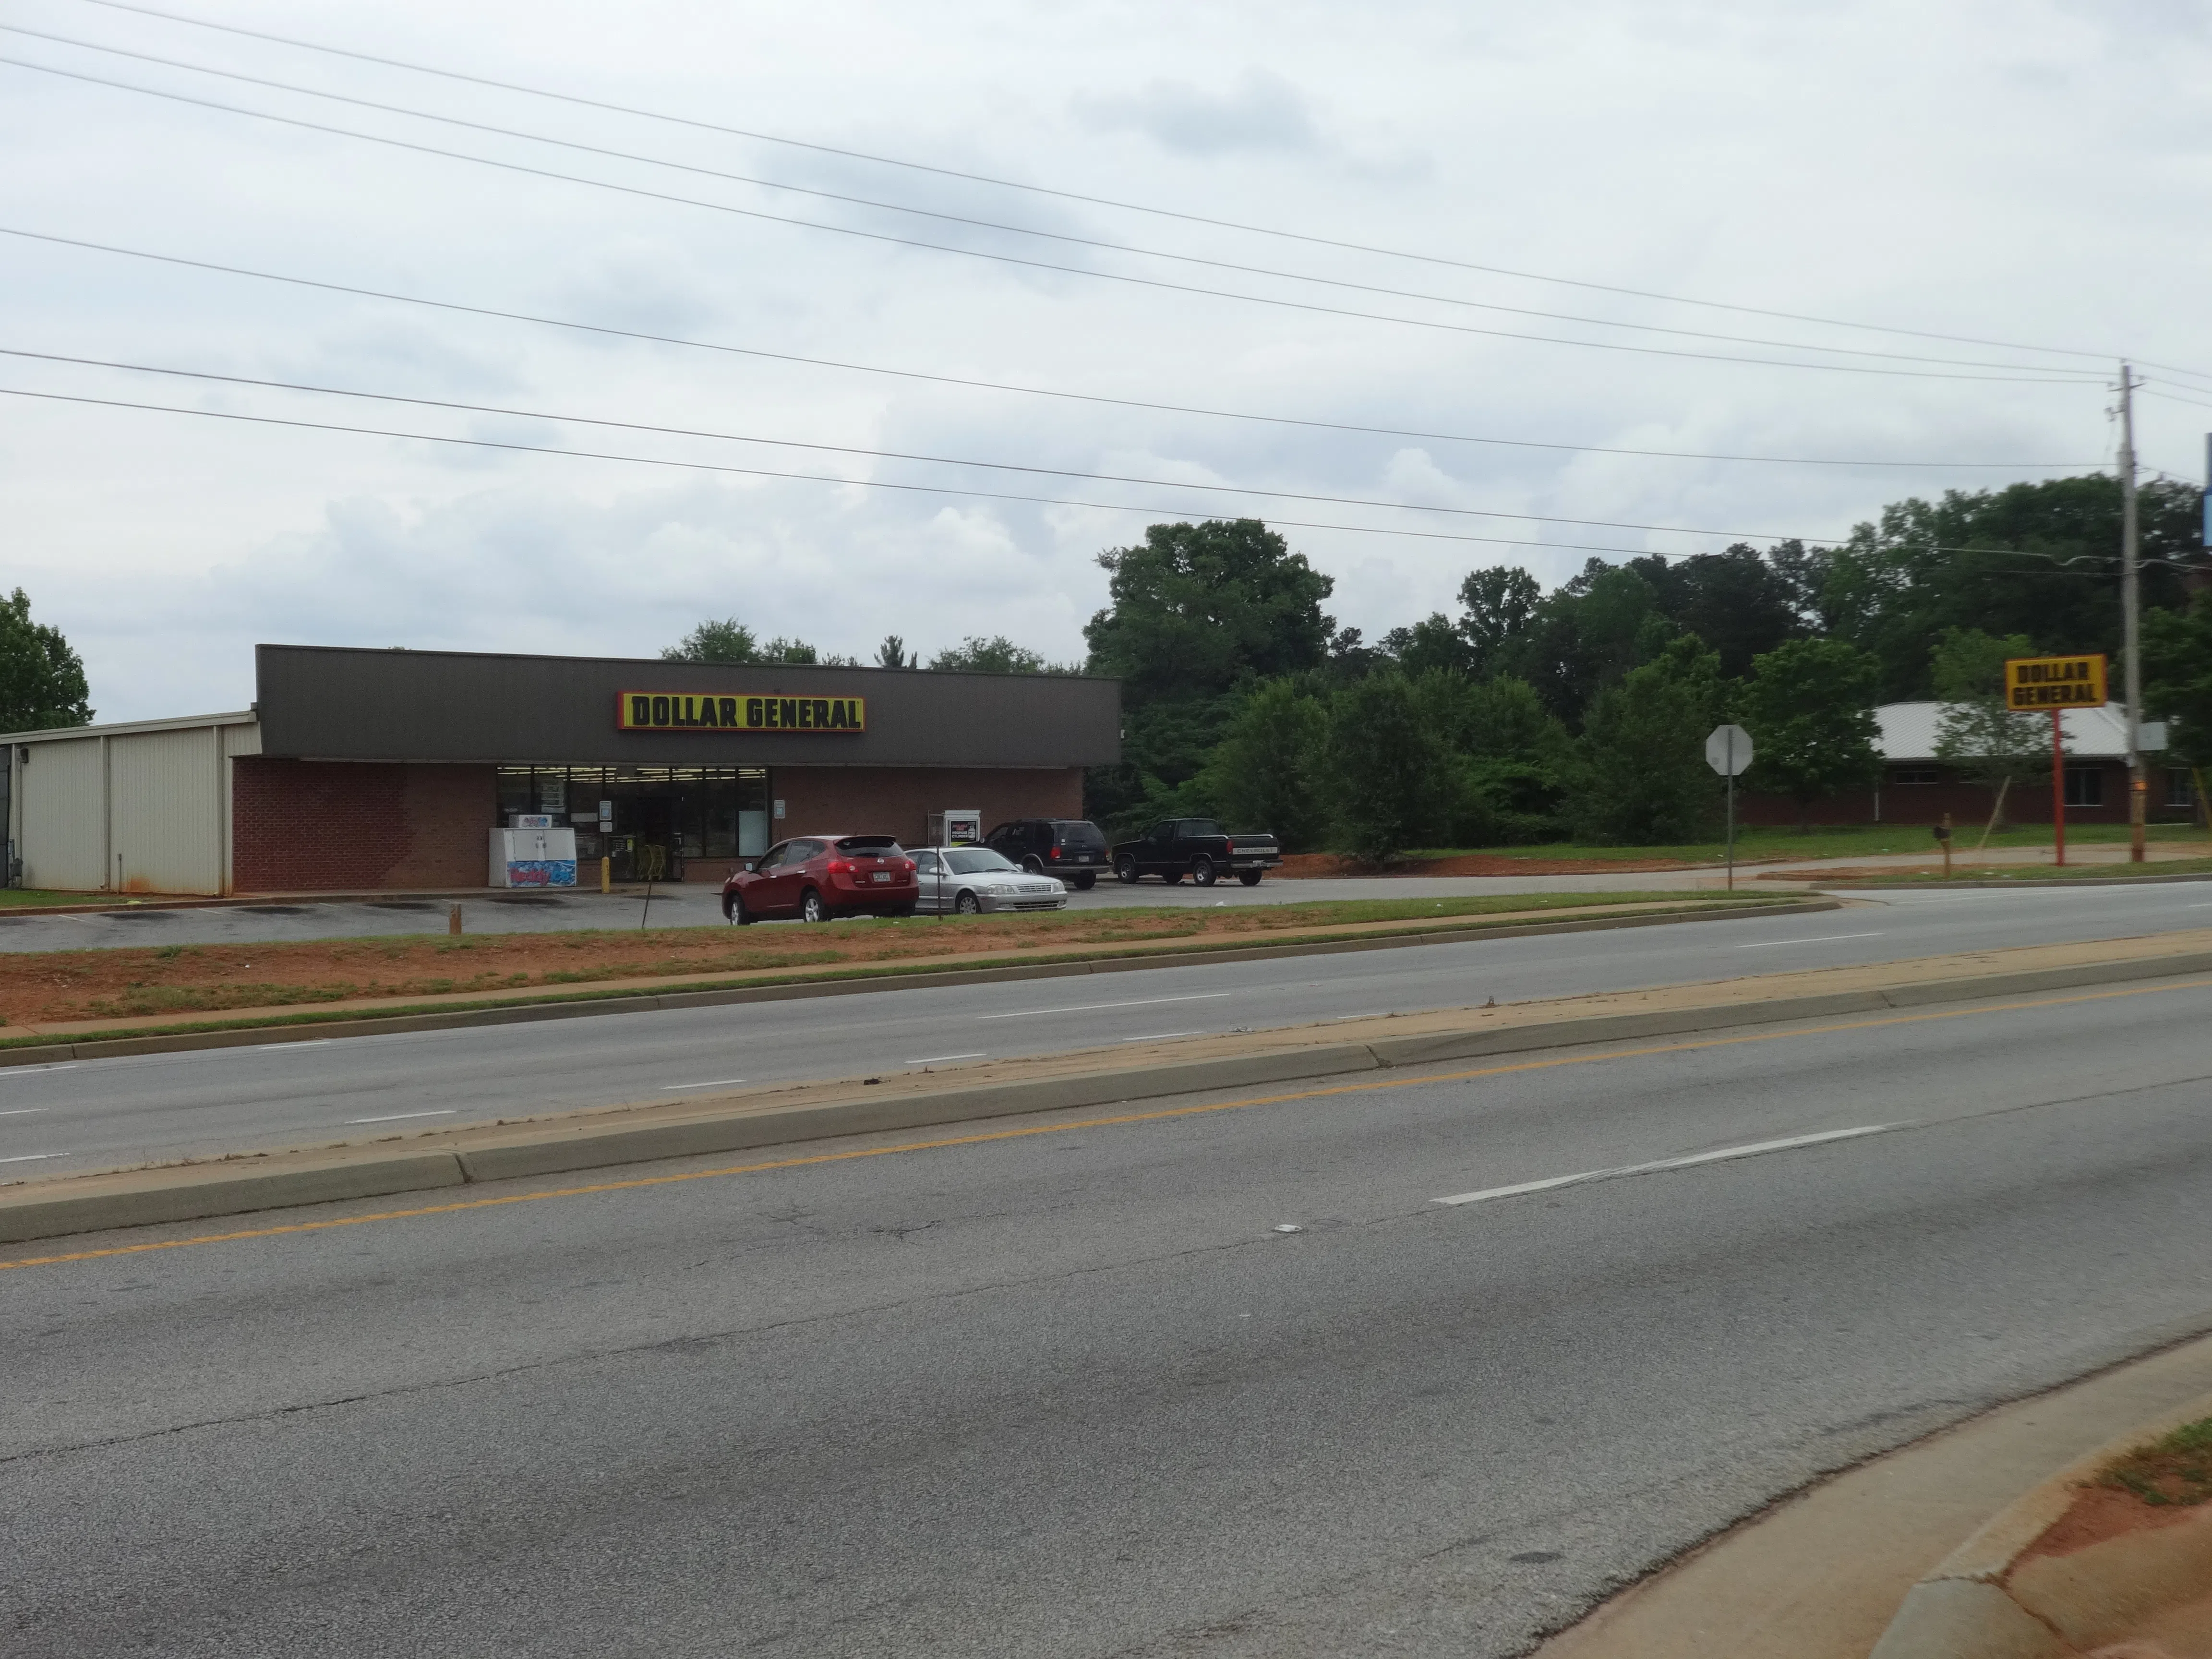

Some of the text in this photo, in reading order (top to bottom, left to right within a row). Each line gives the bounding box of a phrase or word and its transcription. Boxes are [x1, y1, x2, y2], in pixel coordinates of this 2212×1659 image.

[2018, 661, 2089, 684] DOLLAR
[2014, 684, 2097, 706] GENERAL
[631, 696, 861, 728] DOLLAR GENERAL
[510, 867, 551, 886] Reddy
